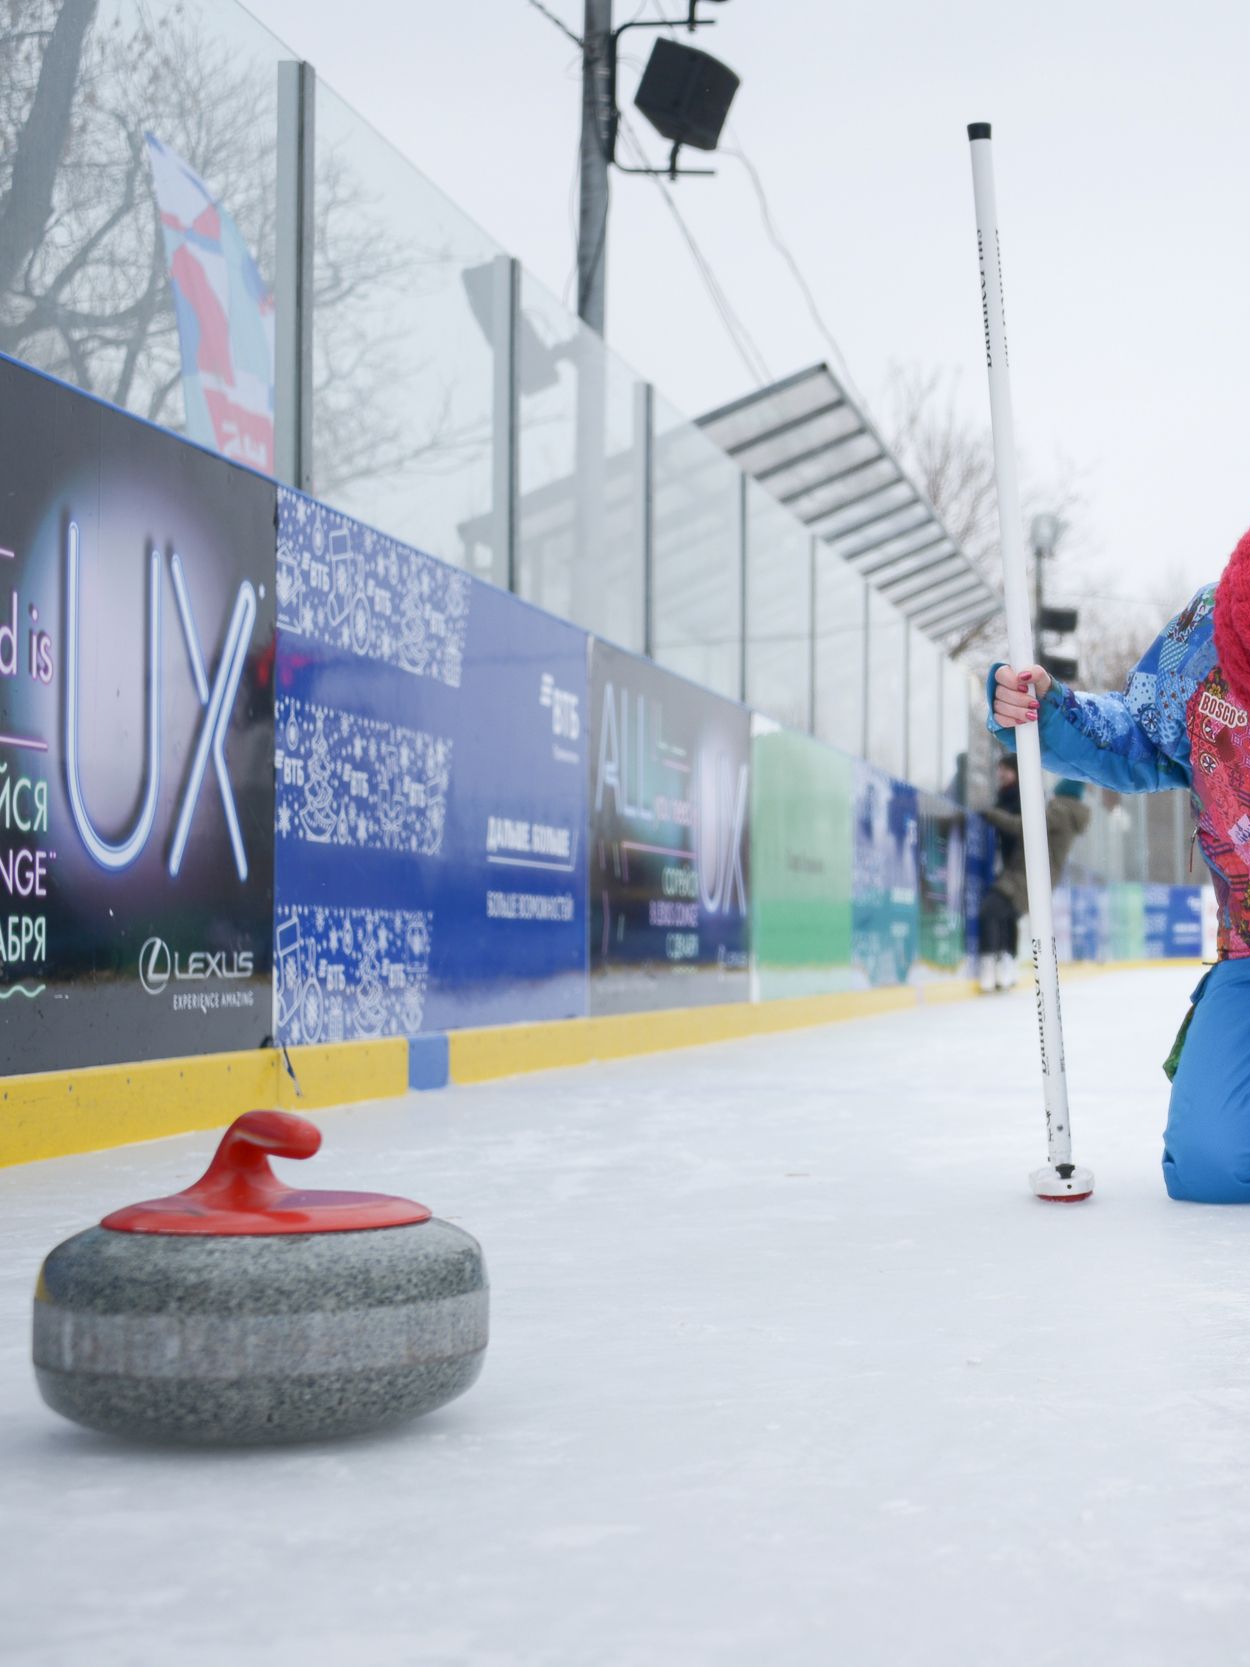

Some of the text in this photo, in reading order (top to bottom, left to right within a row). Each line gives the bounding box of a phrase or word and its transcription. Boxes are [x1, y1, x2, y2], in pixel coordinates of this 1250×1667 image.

[31, 608, 53, 684] is
[65, 519, 257, 882] UX
[1201, 695, 1237, 726] BOSCO
[174, 951, 254, 979] LEXUS
